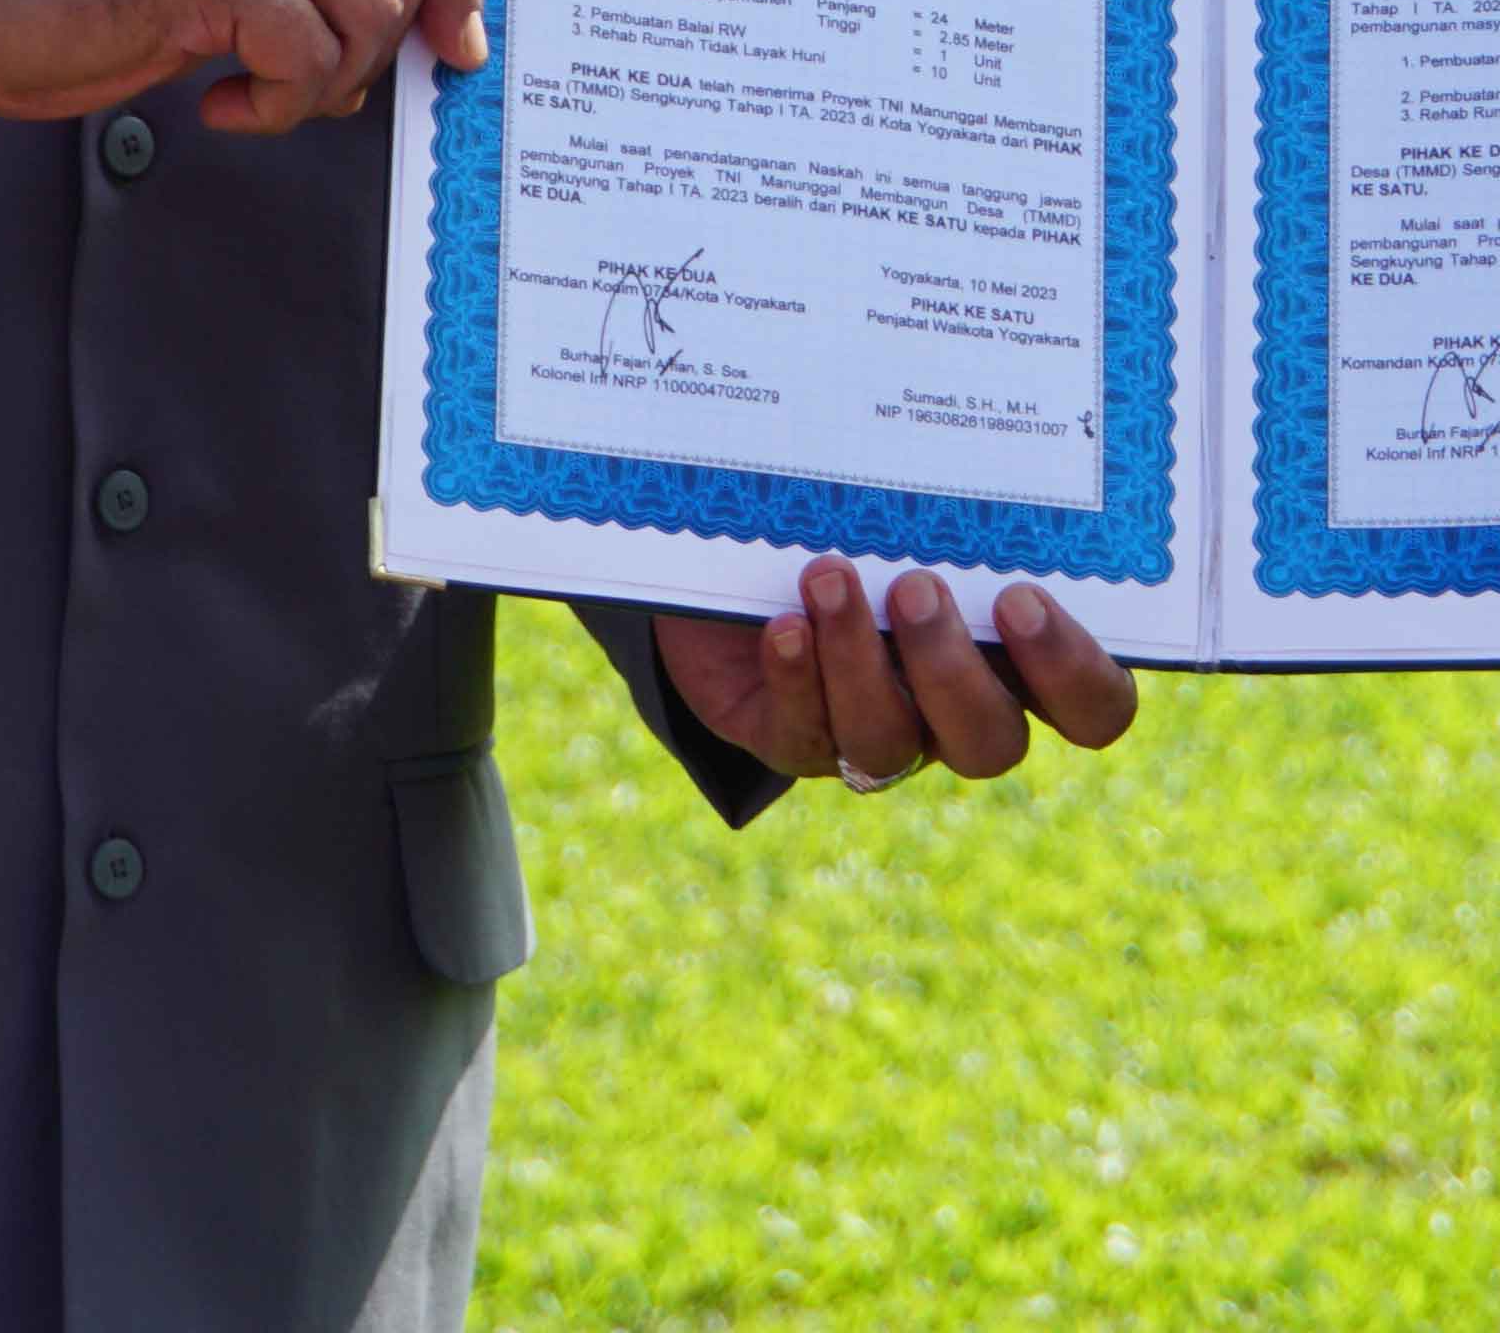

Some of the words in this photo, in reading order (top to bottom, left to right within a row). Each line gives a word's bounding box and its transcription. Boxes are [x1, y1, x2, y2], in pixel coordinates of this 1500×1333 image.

[1350, 0, 1399, 18] Tahap
[1413, 1, 1418, 15] I
[1350, 20, 1458, 36] pembangunan
[970, 278, 987, 293] 10
[990, 280, 1017, 296] Mei
[1020, 284, 1057, 300] 2023
[910, 296, 960, 316] PIHAK
[963, 304, 987, 320] KE
[989, 307, 1035, 325] SATU
[866, 308, 929, 330] Penjabat
[932, 318, 996, 338] Walikota
[997, 327, 1081, 348] Yogyakarta
